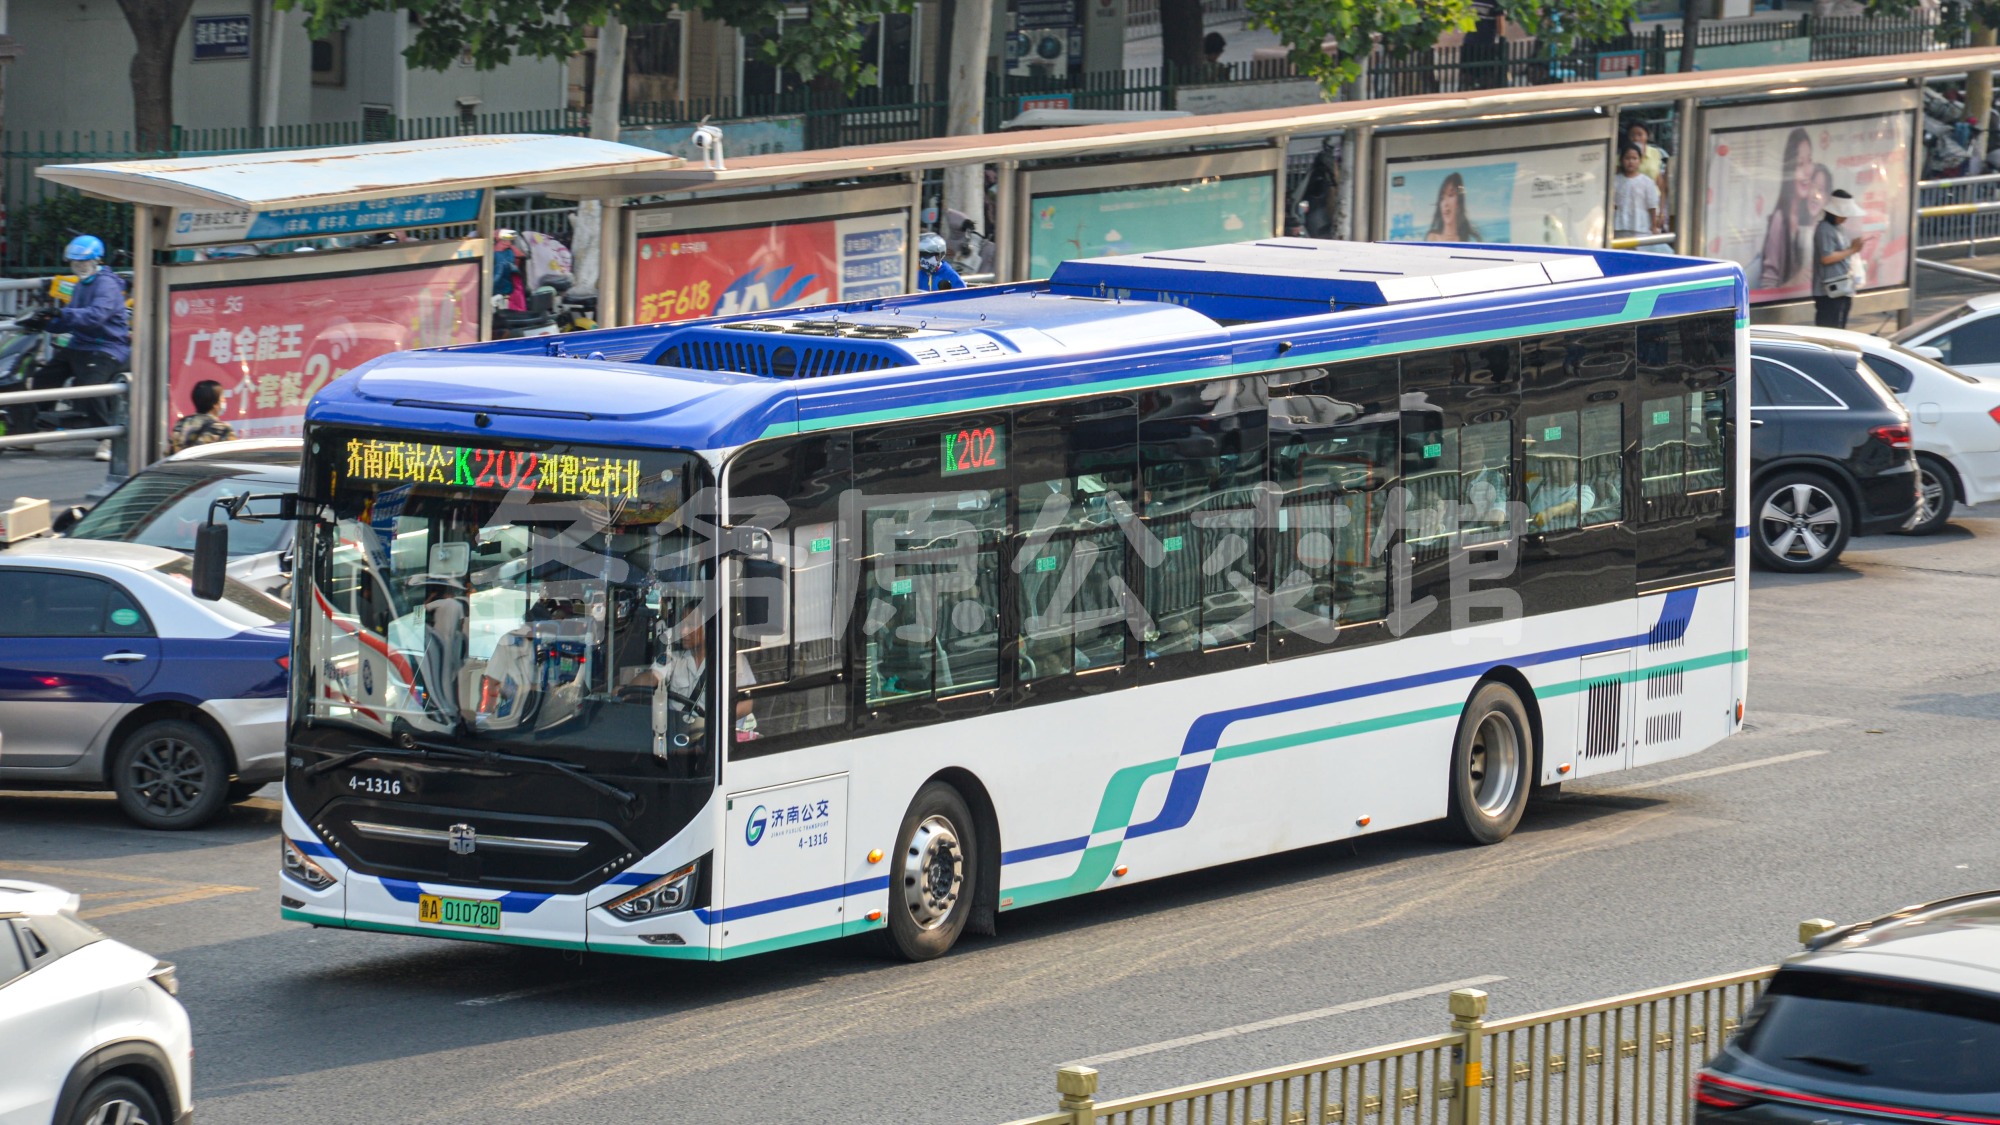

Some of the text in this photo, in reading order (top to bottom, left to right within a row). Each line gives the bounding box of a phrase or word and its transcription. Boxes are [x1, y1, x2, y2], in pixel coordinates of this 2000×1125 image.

[640, 280, 711, 323] 苏宁618
[184, 324, 304, 366] 广电全能王
[945, 427, 996, 471] K202
[453, 446, 537, 491] K202
[348, 776, 401, 795] 4-1316
[771, 799, 829, 828] 济南公交
[803, 820, 829, 831] TRANSPORT
[798, 832, 828, 849] 4-1316
